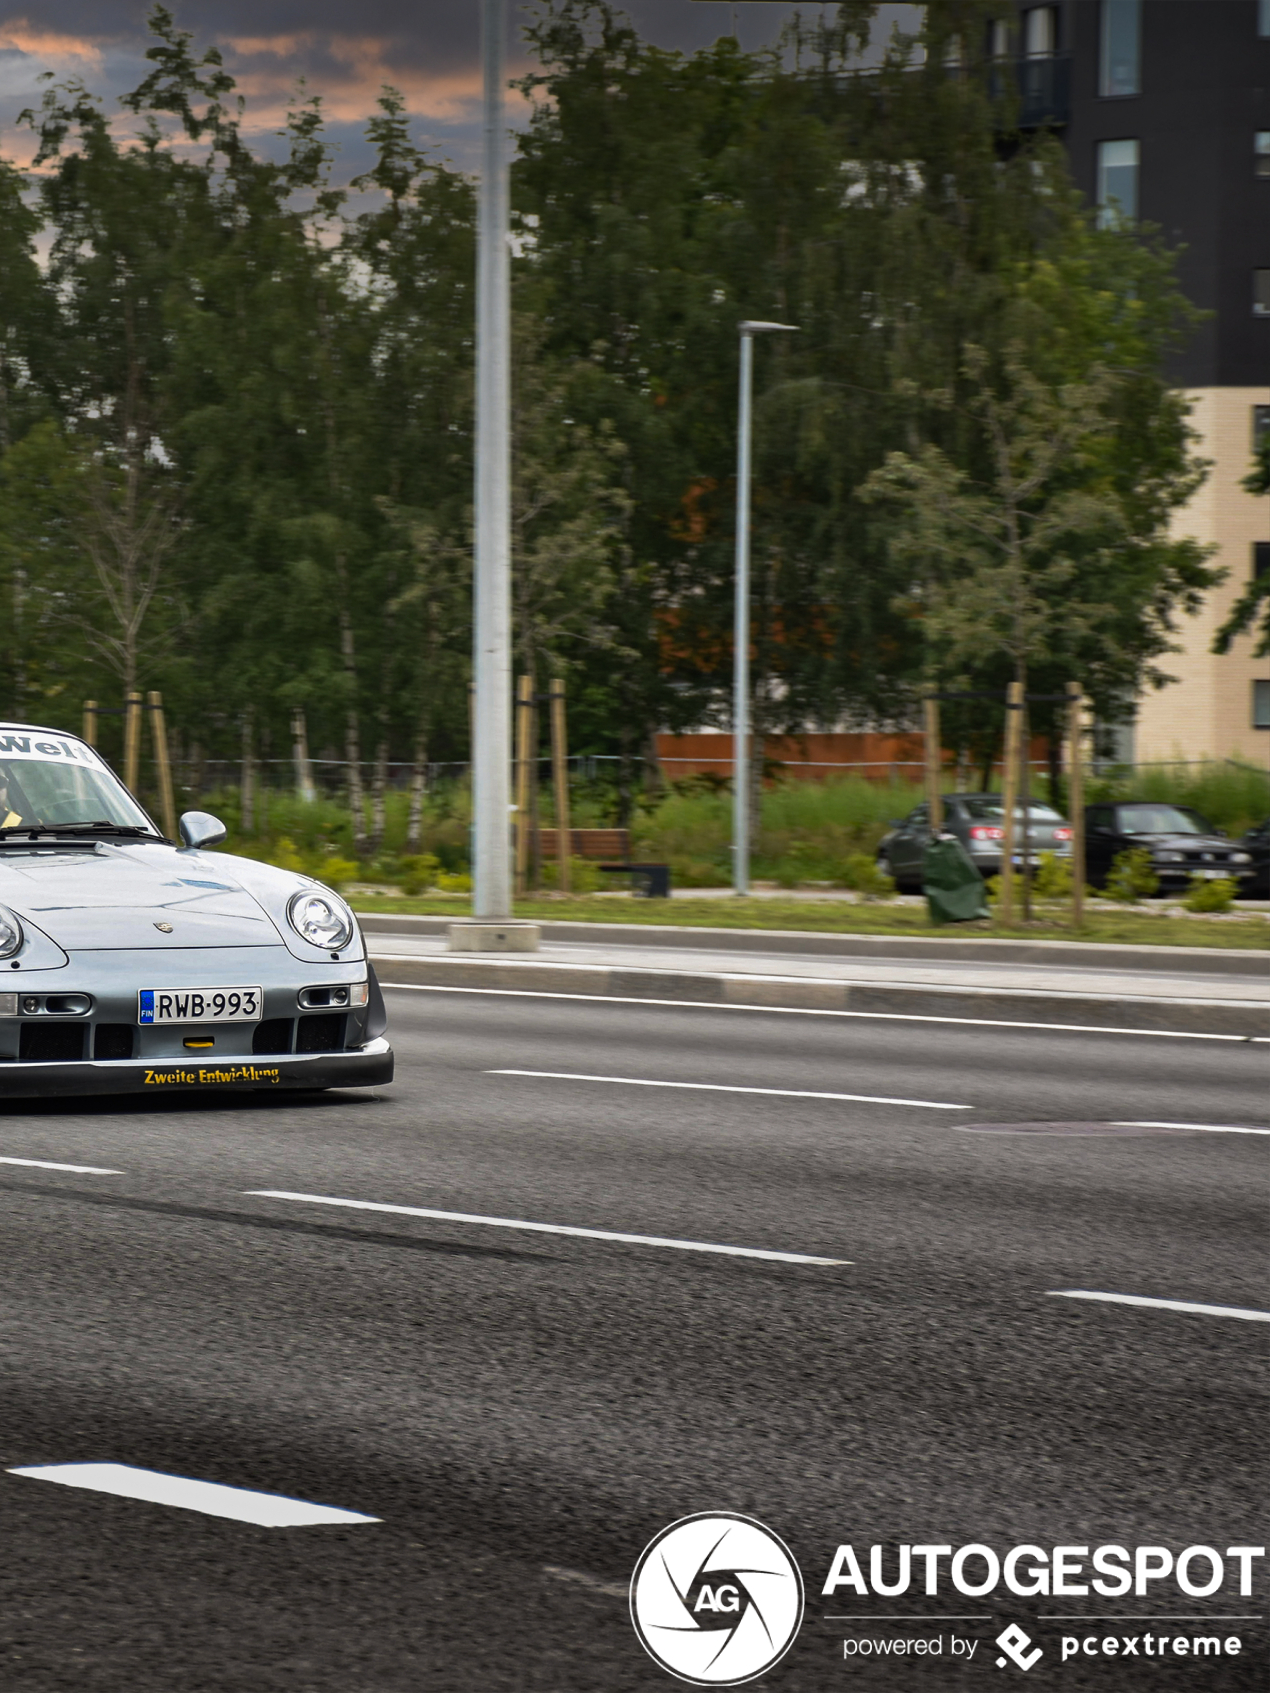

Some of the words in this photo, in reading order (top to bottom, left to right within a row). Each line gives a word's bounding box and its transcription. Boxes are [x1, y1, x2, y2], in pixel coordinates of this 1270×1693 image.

[141, 1010, 154, 1018] FIN
[159, 992, 256, 1018] RWB-993
[144, 1069, 195, 1084] Zweite
[198, 1066, 280, 1083] Entwicklung
